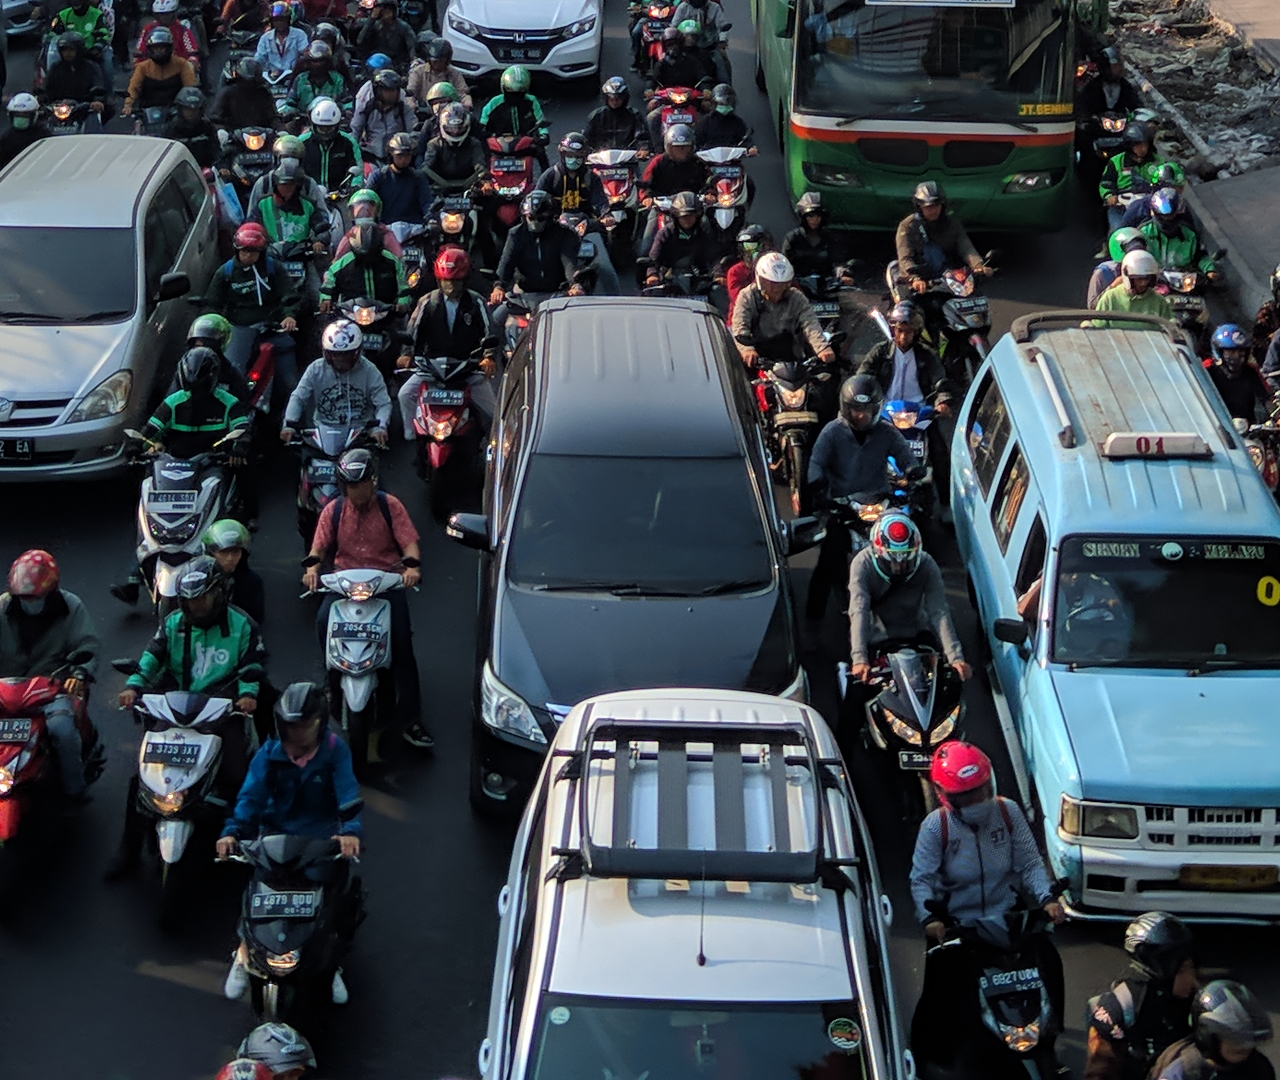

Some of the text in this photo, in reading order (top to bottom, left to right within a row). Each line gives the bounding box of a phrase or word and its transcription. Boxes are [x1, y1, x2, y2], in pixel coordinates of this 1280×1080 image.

[16, 441, 29, 453] EA
[1136, 437, 1165, 455] 01
[146, 744, 153, 753] B
[254, 897, 261, 907] B
[980, 977, 988, 989] B
